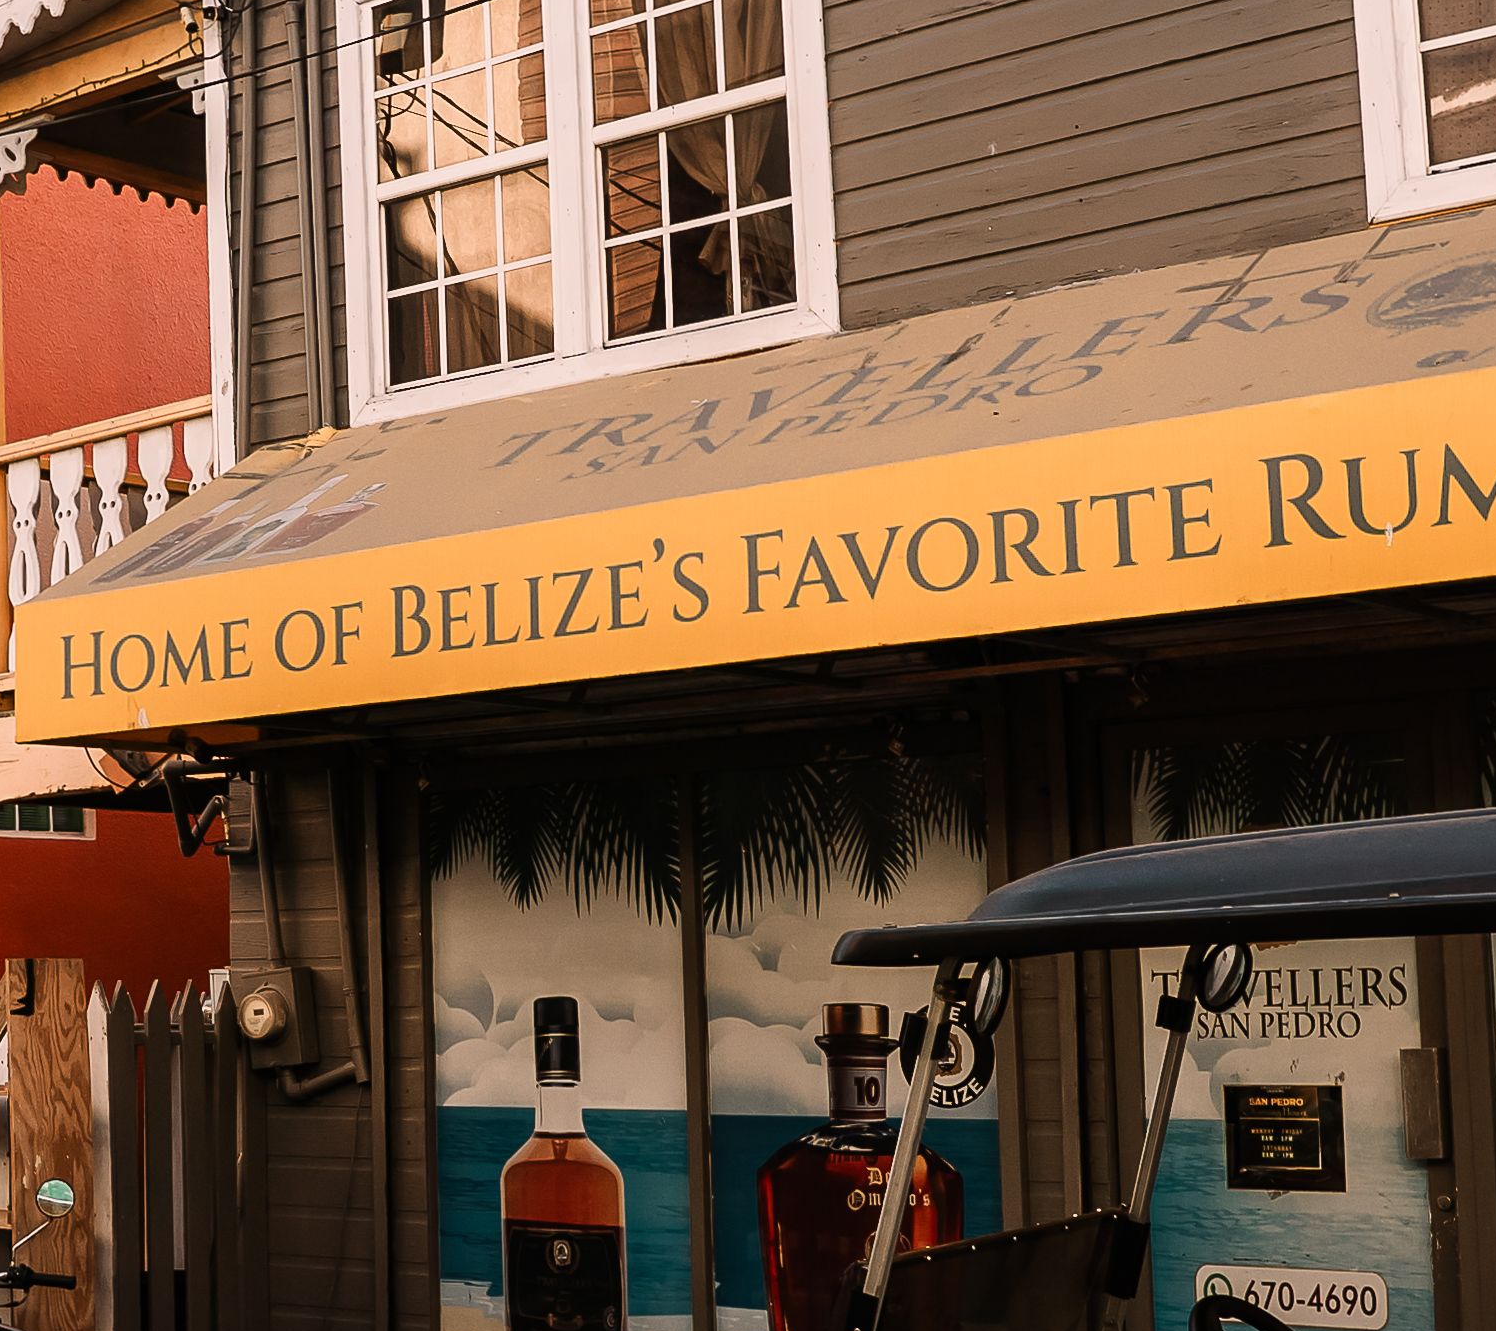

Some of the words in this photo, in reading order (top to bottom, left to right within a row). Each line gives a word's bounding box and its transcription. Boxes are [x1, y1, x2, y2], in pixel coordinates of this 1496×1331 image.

[560, 431, 742, 482] SAN
[747, 363, 1105, 446] PEDRO
[61, 618, 253, 700] HOME
[274, 601, 364, 672] OF
[390, 539, 709, 659] BELIZE'S
[739, 479, 1224, 614] FAVORITE
[1197, 1012, 1250, 1041] SAN
[1259, 1011, 1361, 1039] PEDRO
[853, 1077, 881, 1106] 10
[1248, 1097, 1269, 1107] SAN
[1270, 1098, 1304, 1107] PEDRO
[1245, 1280, 1377, 1316] 670-4690
